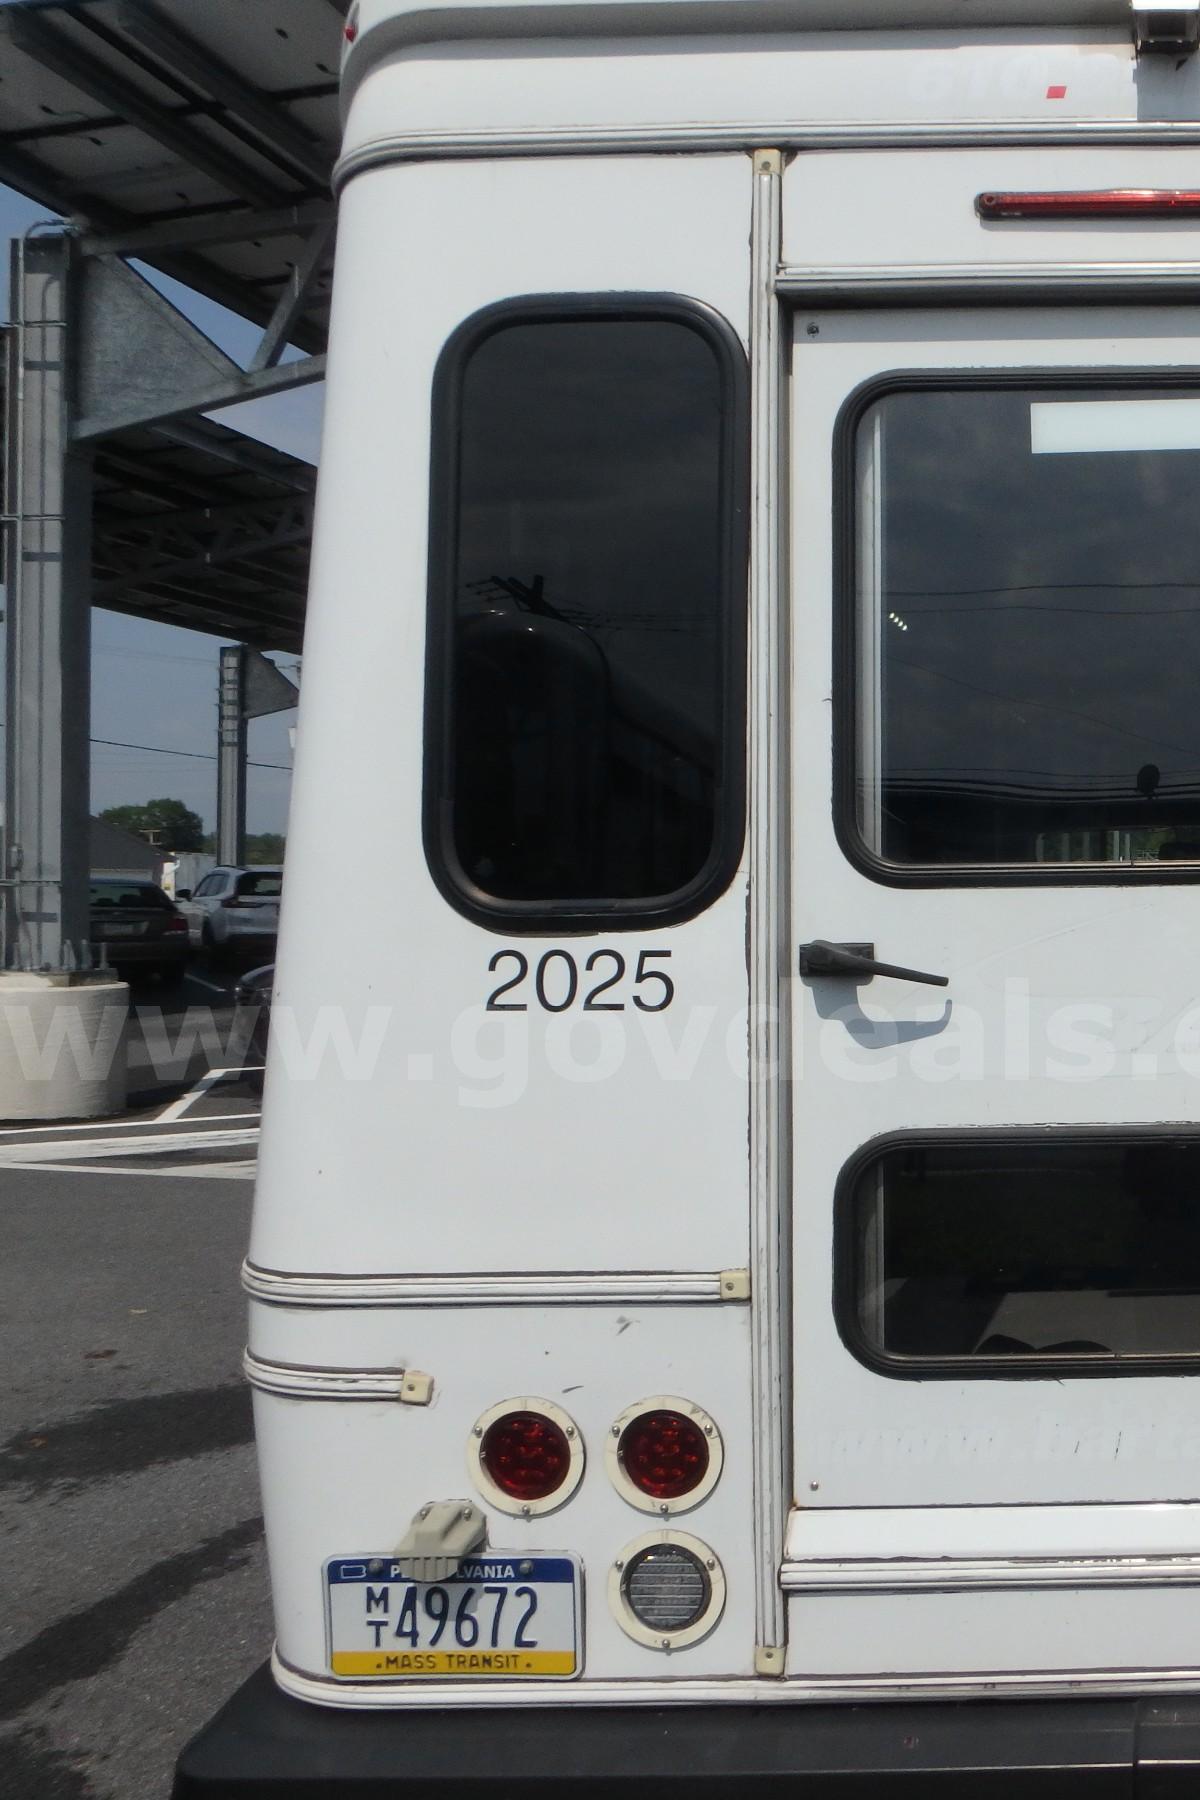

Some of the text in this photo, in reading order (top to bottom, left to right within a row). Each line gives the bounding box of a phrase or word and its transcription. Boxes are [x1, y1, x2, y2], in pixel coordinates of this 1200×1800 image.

[485, 949, 675, 1012] 2025
[390, 1564, 515, 1579] PLVANIA
[395, 1586, 538, 1648] 49672
[385, 1654, 521, 1670] MASS TRANSIT
